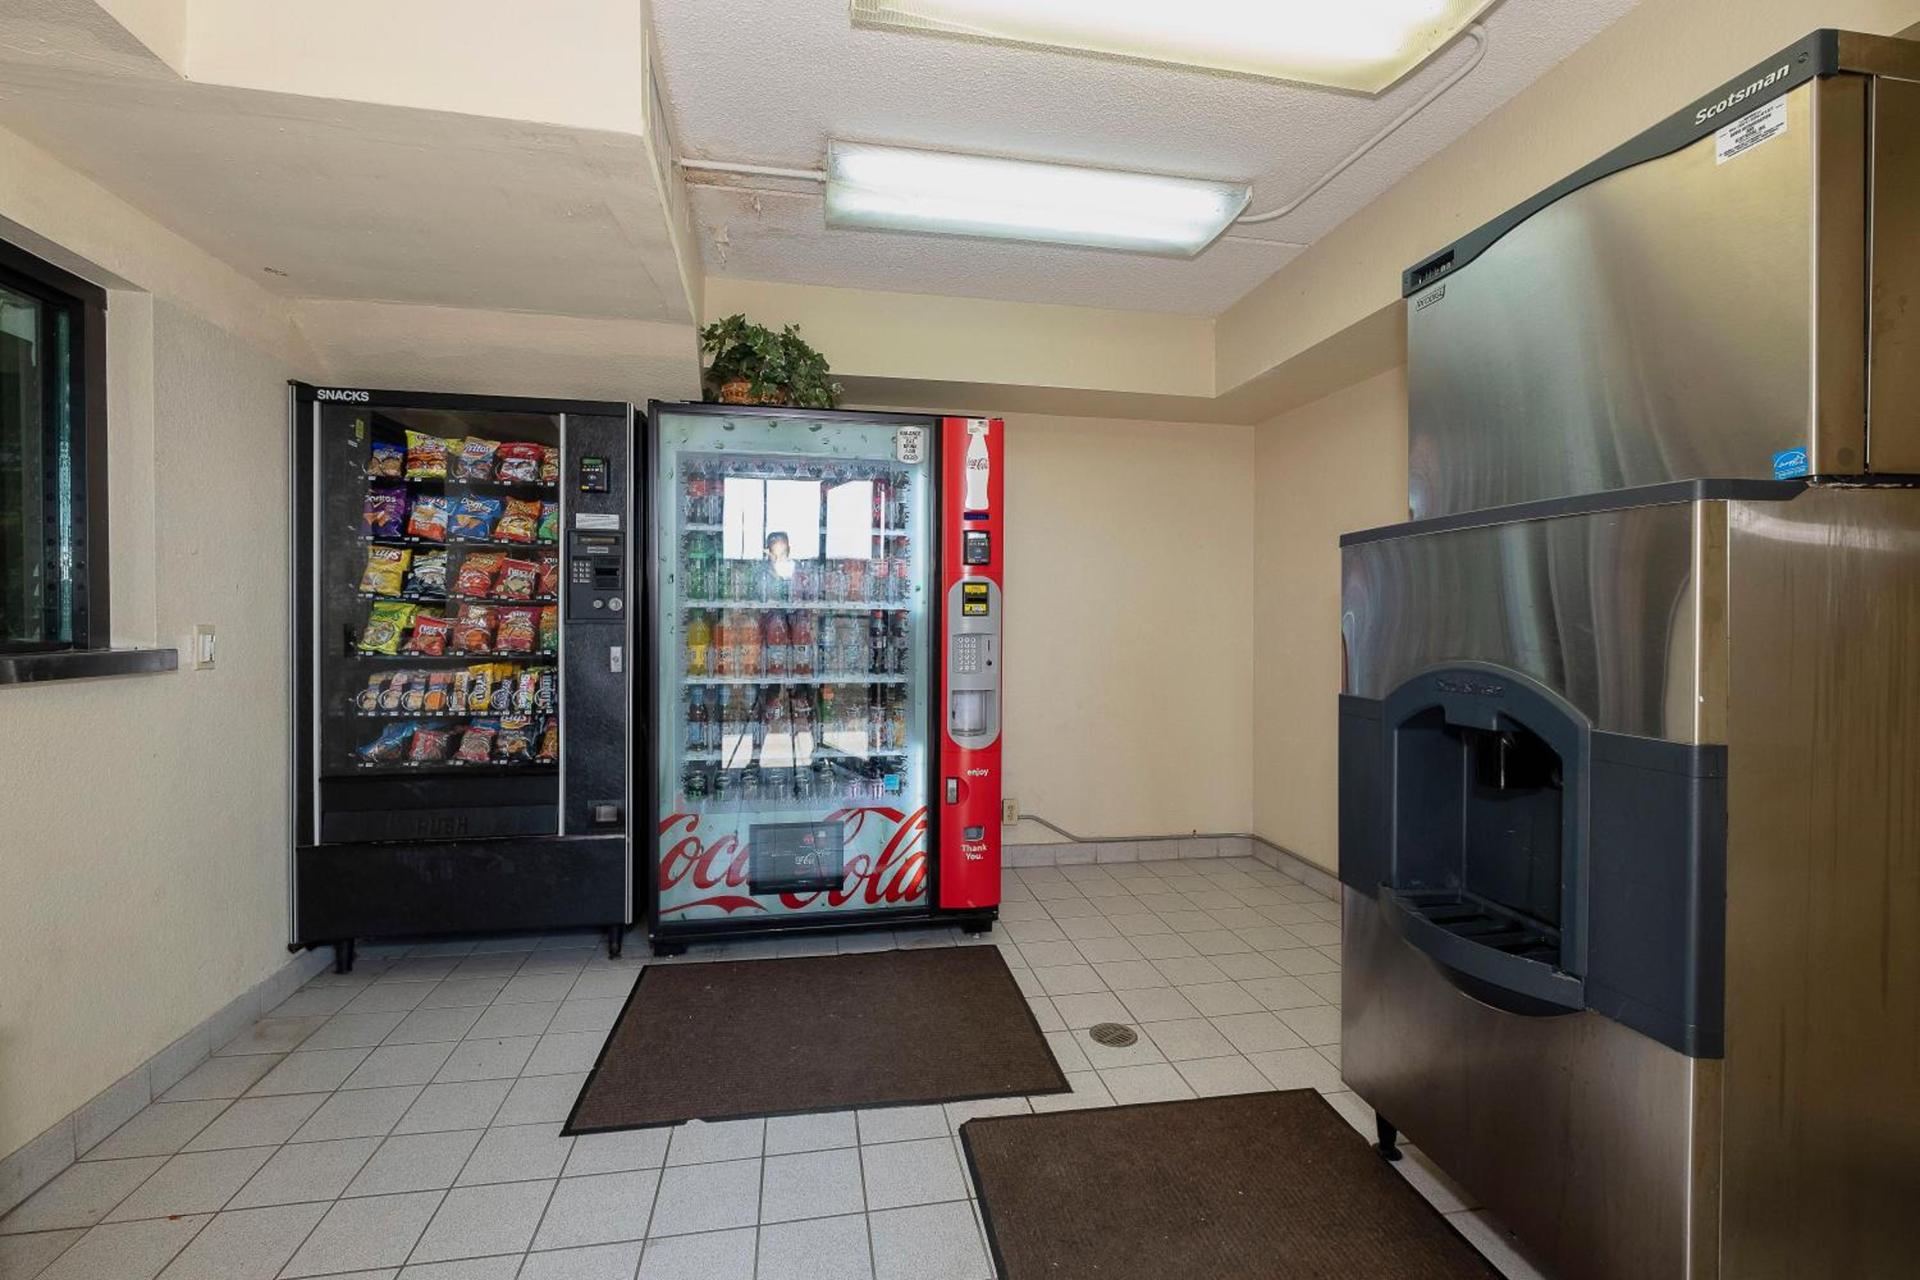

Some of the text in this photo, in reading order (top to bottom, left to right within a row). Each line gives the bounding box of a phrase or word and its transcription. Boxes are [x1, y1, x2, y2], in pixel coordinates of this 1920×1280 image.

[1694, 64, 1790, 126] Scotsman
[317, 388, 369, 402] SNACKS
[966, 768, 989, 777] enjoy
[961, 844, 987, 852] Thank
